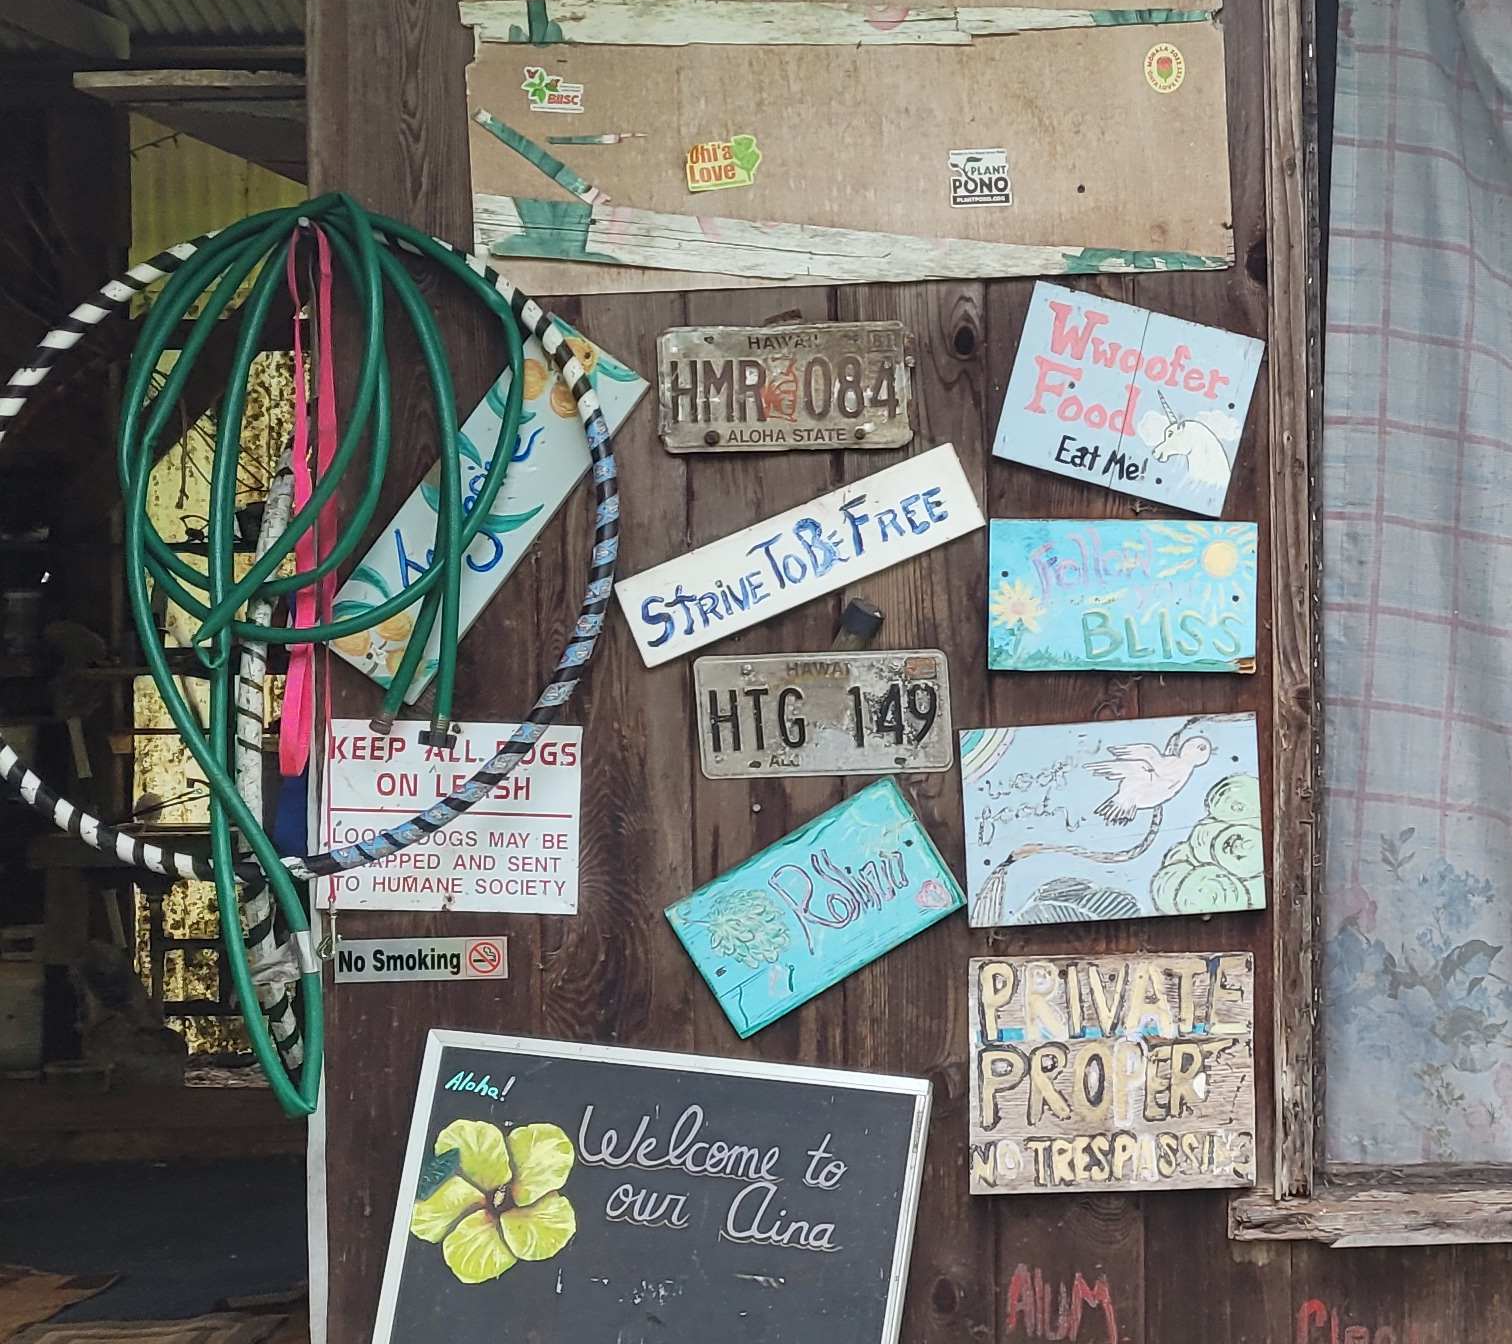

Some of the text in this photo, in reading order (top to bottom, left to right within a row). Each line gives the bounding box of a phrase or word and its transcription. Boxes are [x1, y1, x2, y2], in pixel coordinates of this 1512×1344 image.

[688, 163, 737, 184] Love
[952, 176, 1009, 194] PONO
[970, 165, 1007, 176] PLANT
[1048, 298, 1231, 400] Wwoofer
[669, 355, 900, 424] HMR 084
[1023, 354, 1141, 438] Food
[727, 427, 848, 444] ALOHA STATE
[1054, 433, 1148, 483] Eat Me!
[1081, 607, 1244, 663] BLISS
[707, 682, 940, 754] HTG 149
[330, 736, 406, 760] KEEP
[424, 745, 477, 763] ALL
[376, 772, 531, 801] ON LESH
[488, 831, 530, 849] MAY
[542, 833, 569, 850] BE
[453, 854, 497, 871] AND
[507, 856, 562, 873] SENT
[334, 875, 567, 897] TO HUMANE SOCIETY
[338, 947, 462, 976] No Smoking
[978, 957, 1246, 1044] PRIVATE
[444, 1070, 517, 1102] Aloha!
[577, 1104, 849, 1189] Welcome to
[971, 1138, 1024, 1189] NO
[605, 1182, 691, 1228] our
